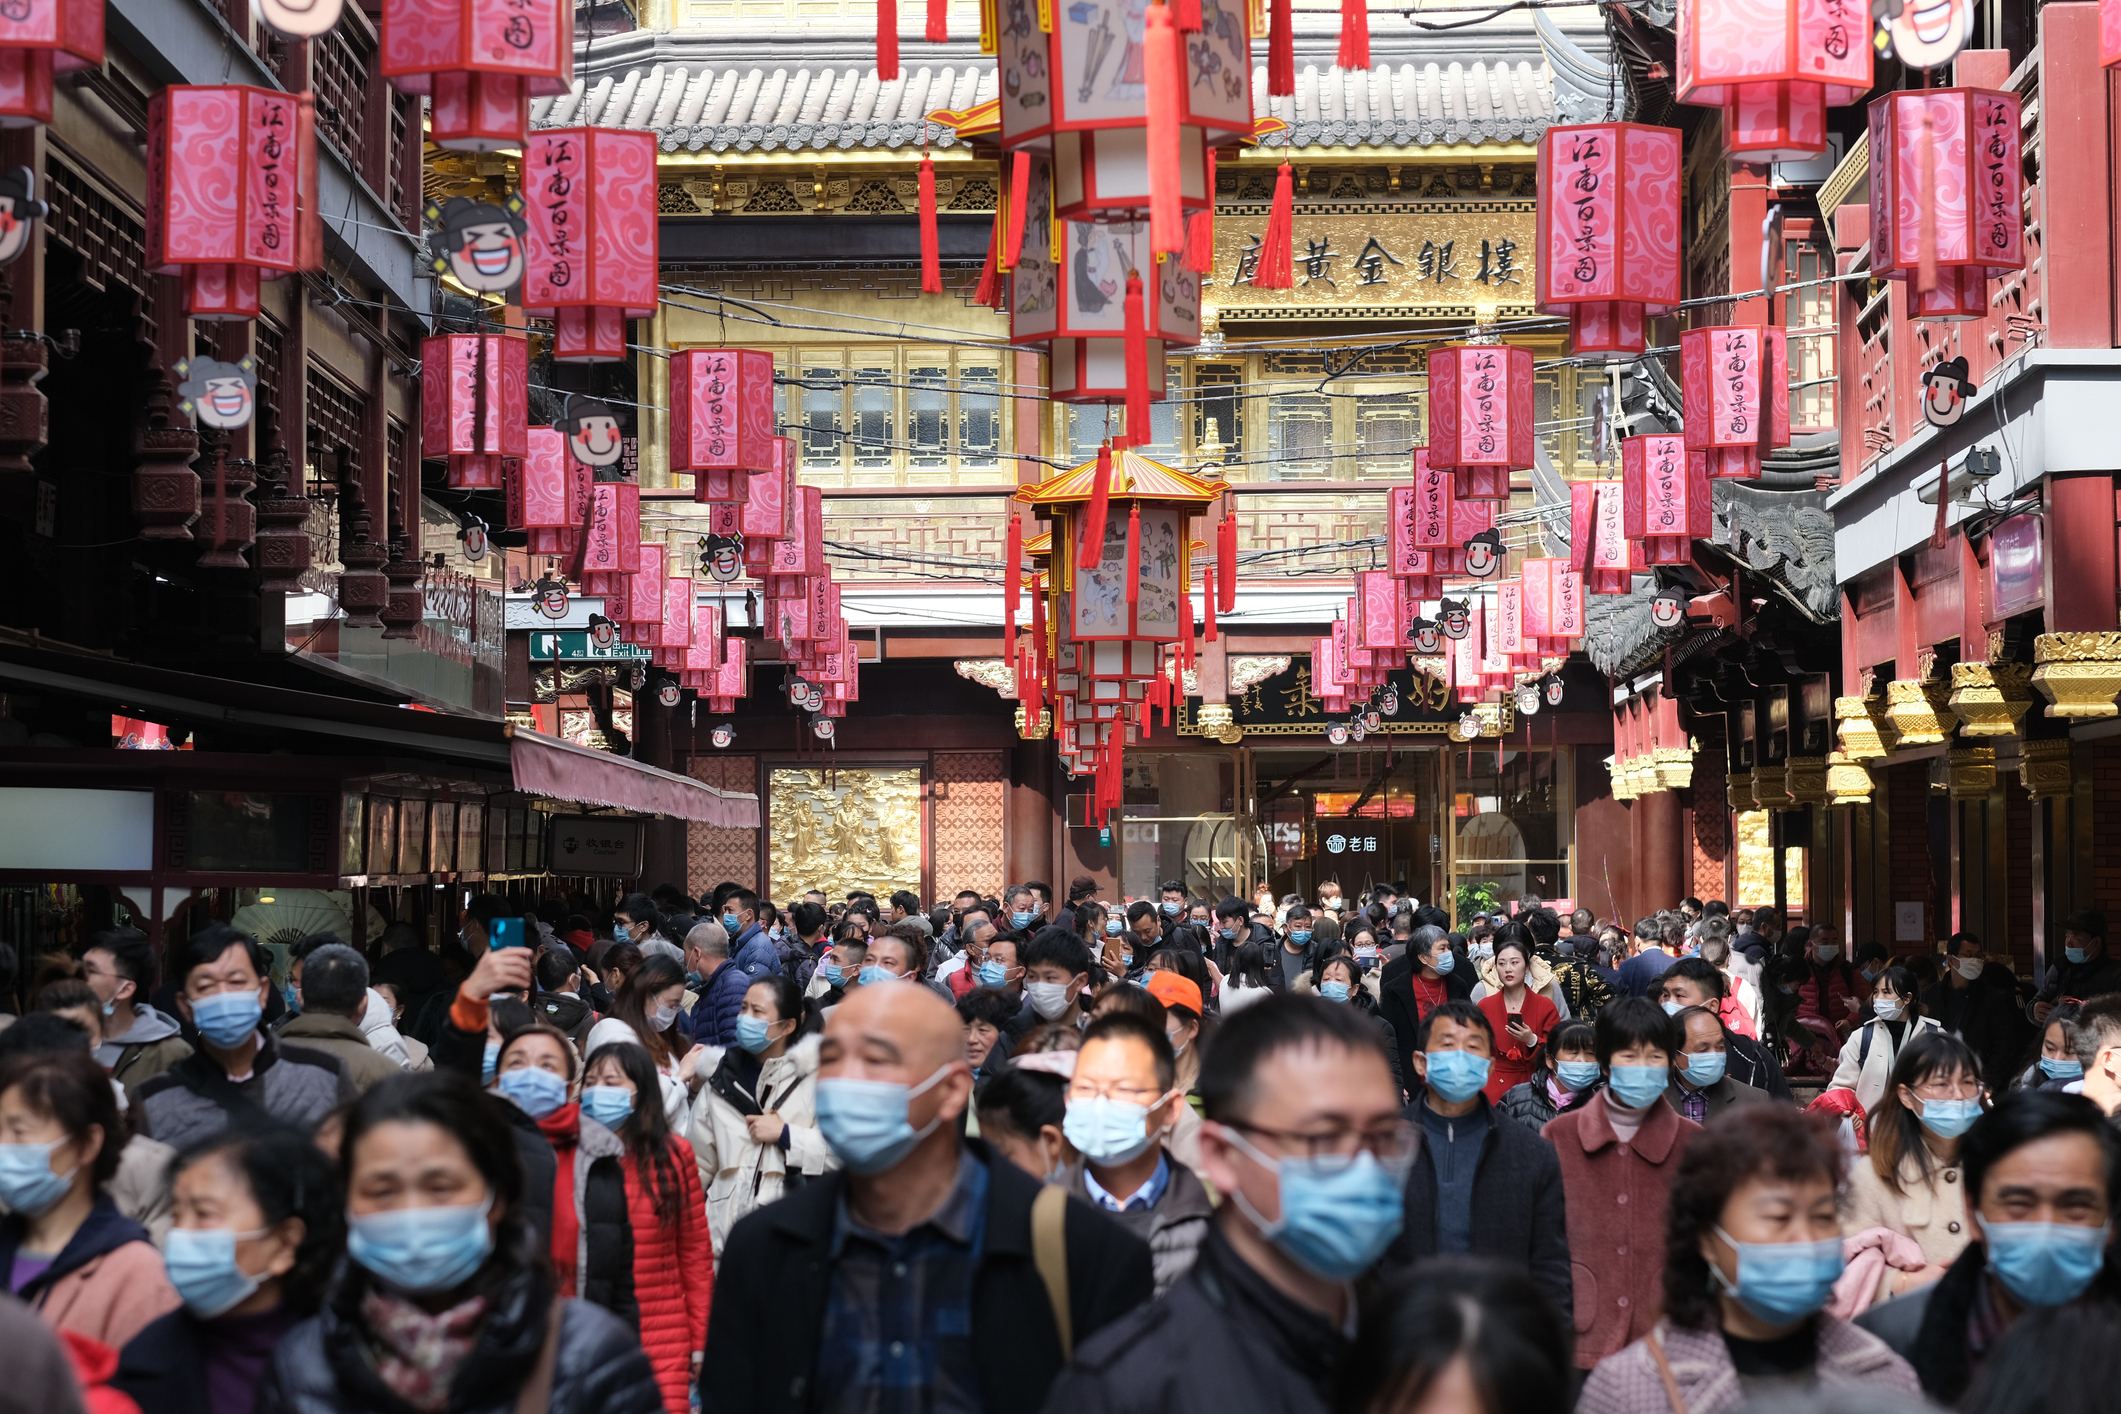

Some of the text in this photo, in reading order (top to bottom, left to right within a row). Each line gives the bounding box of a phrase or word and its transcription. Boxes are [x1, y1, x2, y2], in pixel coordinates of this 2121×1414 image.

[504, 0, 533, 49] 图
[262, 99, 284, 249] 江南百景图
[545, 138, 573, 287] 江南百景图
[1572, 134, 1601, 283] 江南百景图
[1986, 99, 2008, 249] 江南百景图
[705, 355, 726, 457] 江南百景图
[1475, 352, 1496, 454] 江南百景图
[1725, 332, 1748, 435] 江南百景图
[1603, 485, 1619, 561] 江南百景图
[1657, 439, 1676, 526] 江南百景图
[595, 488, 609, 563] 江南百景图
[1505, 587, 1516, 647] 江南百景图
[1561, 562, 1574, 629] 江南百景图
[613, 649, 629, 658] Exit
[586, 838, 626, 849] 收银台
[1348, 836, 1377, 852] 老庙
